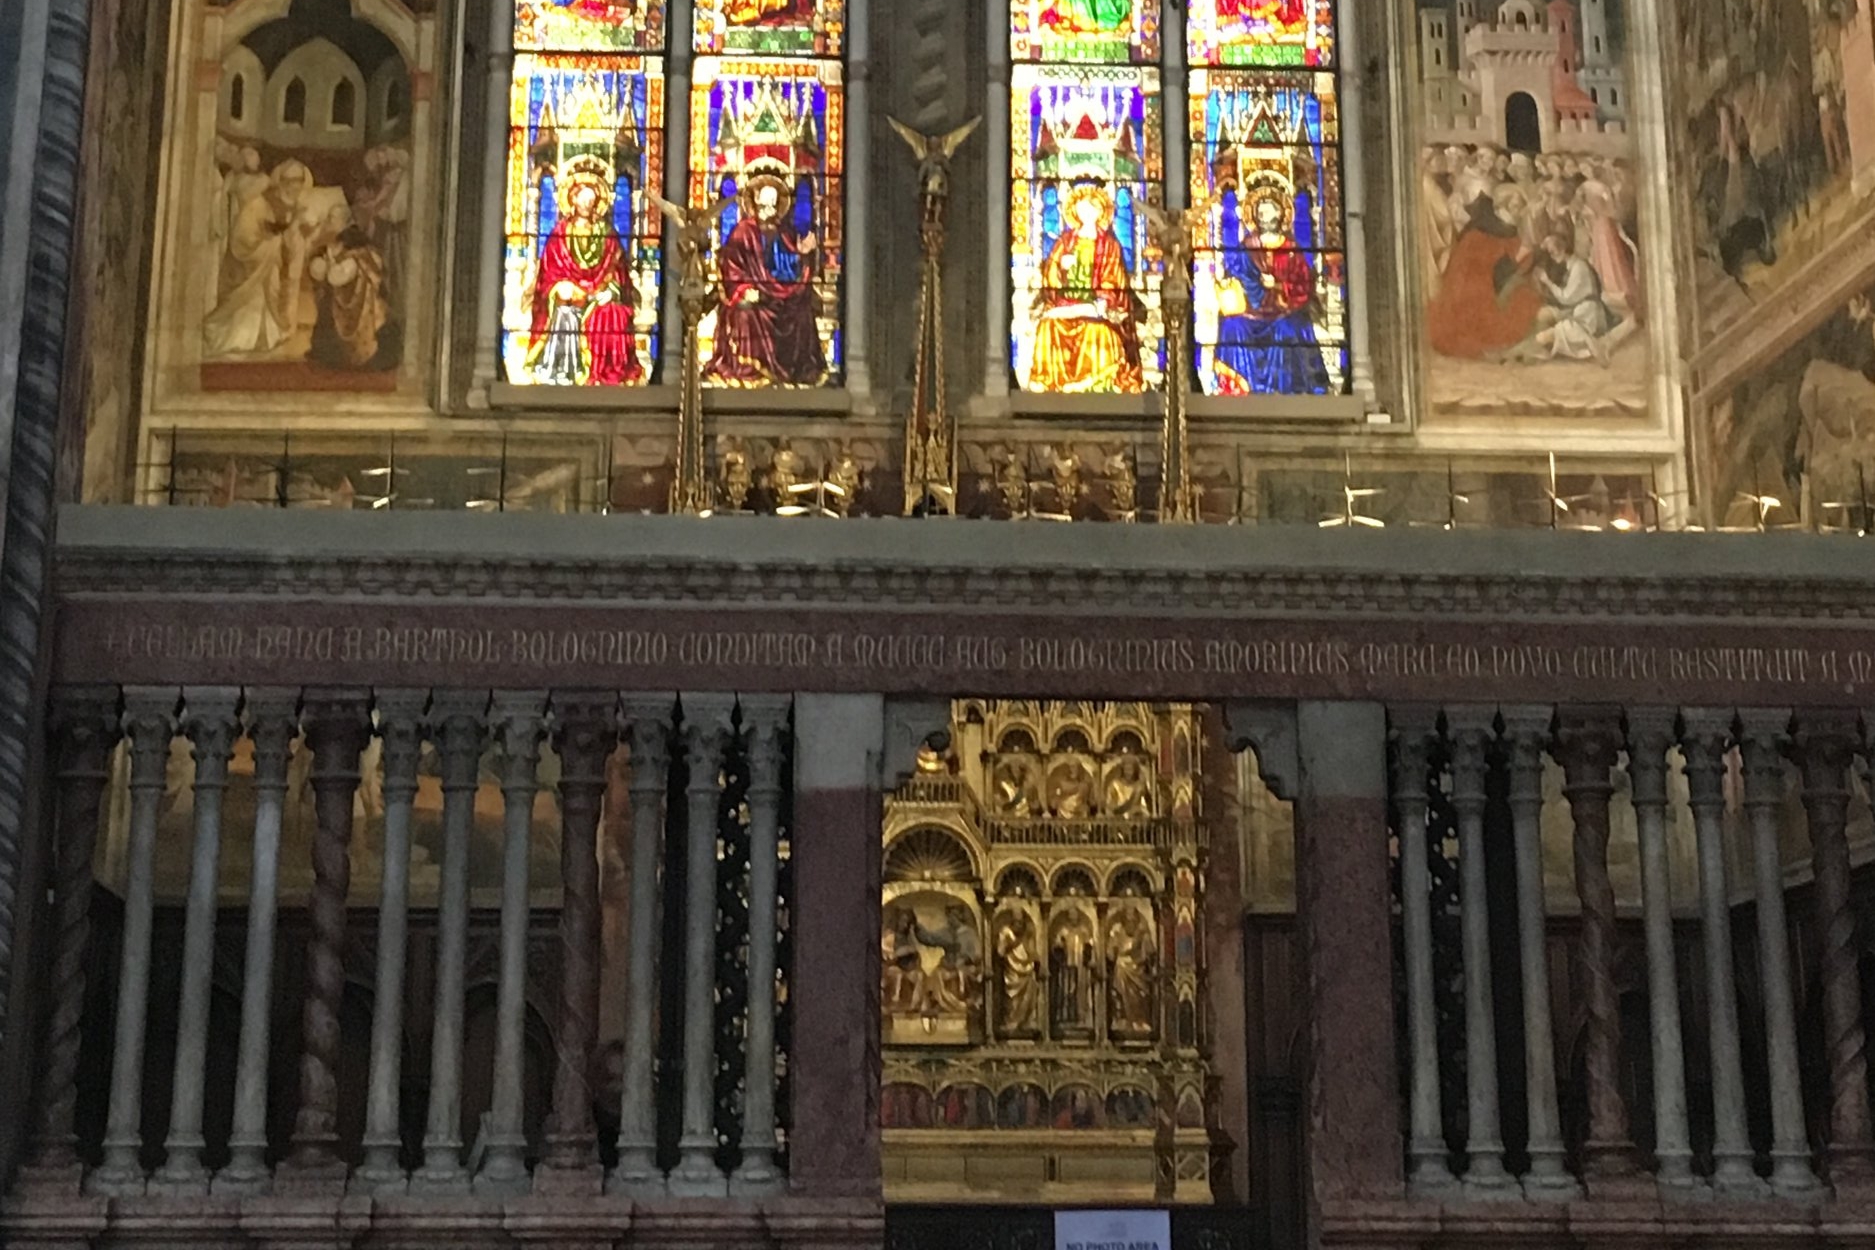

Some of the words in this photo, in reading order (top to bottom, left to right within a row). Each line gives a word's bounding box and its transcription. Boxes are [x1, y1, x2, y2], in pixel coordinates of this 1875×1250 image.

[256, 626, 333, 660] HANC
[340, 627, 362, 662] A
[512, 629, 667, 665] BOLOGNINIO
[679, 632, 816, 666] CONDITAM
[823, 633, 842, 667] A
[1492, 645, 1560, 677] NOVO
[1066, 1241, 1083, 1250] NO
[1086, 1241, 1125, 1250] PHOTO
[1128, 1241, 1159, 1250] AREA
